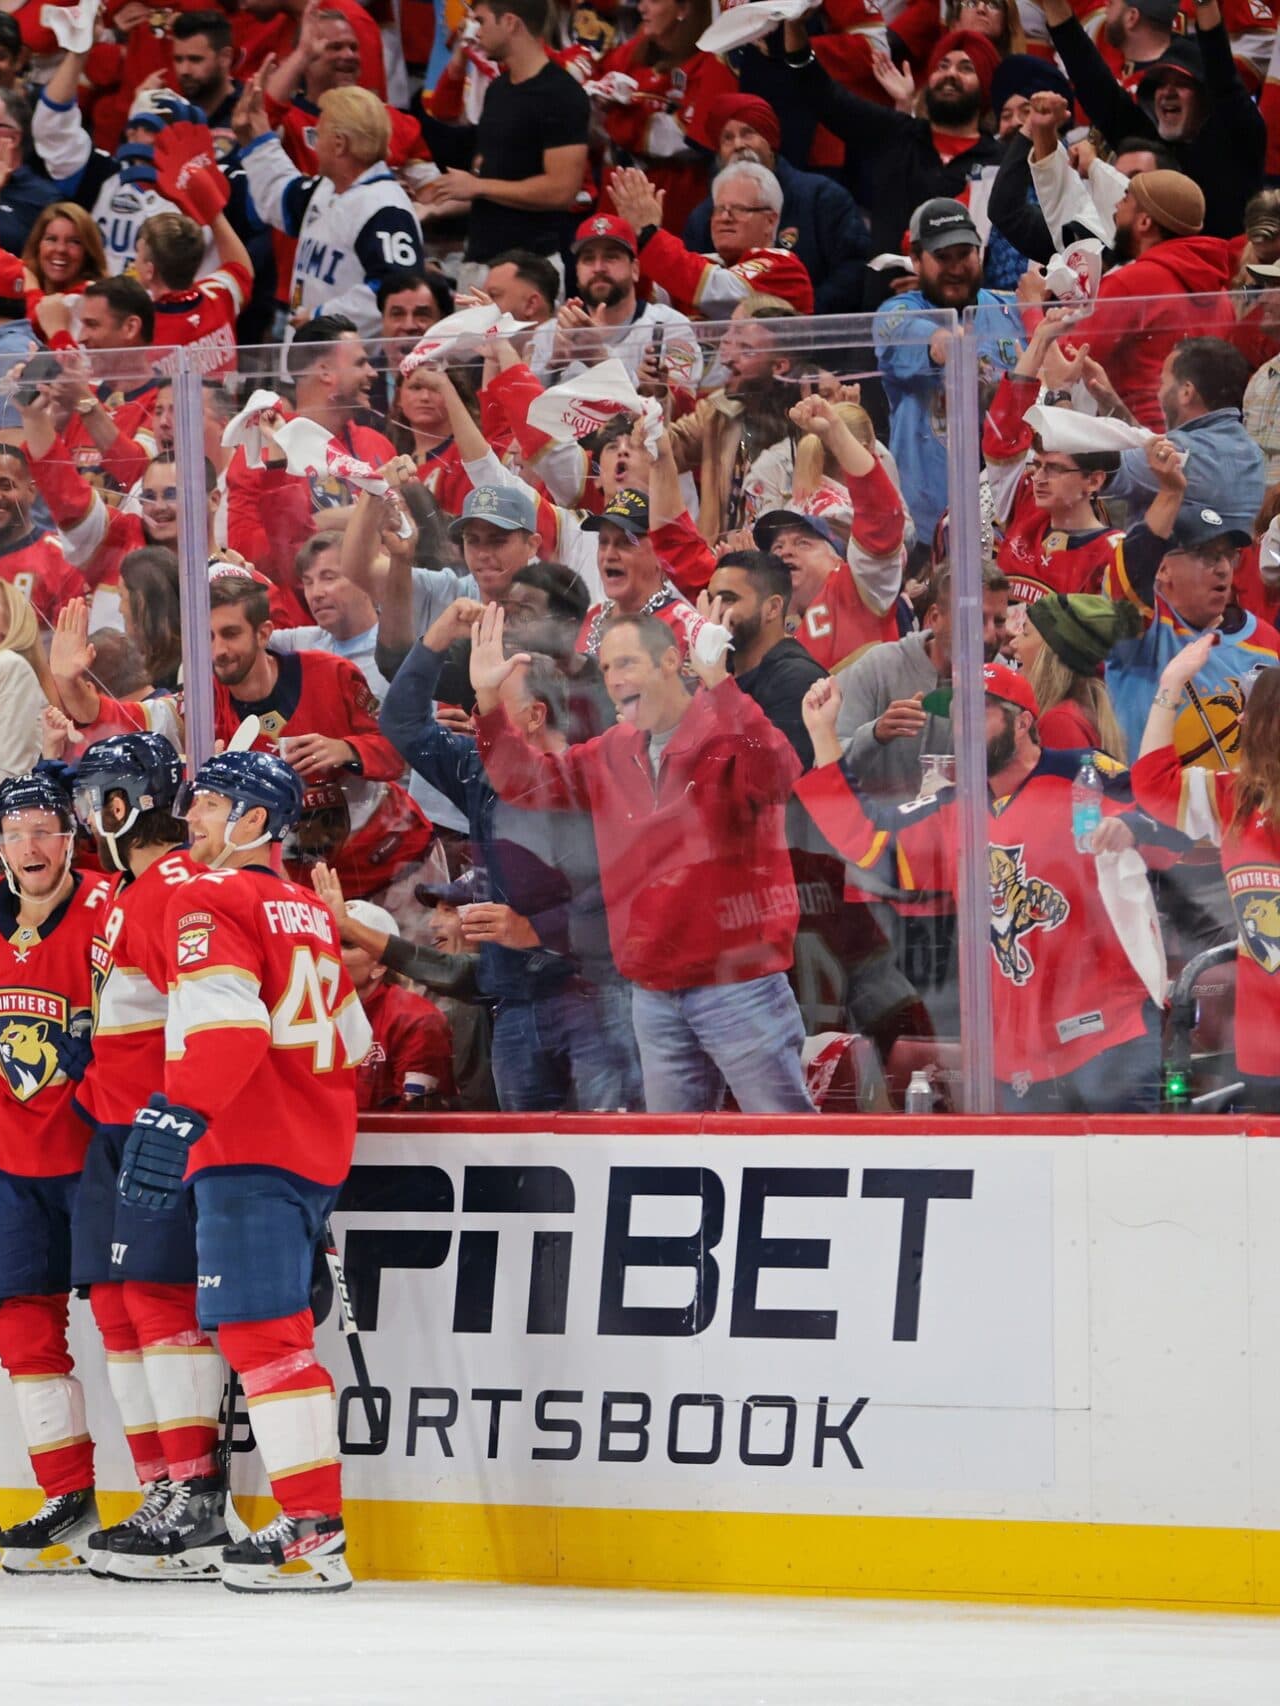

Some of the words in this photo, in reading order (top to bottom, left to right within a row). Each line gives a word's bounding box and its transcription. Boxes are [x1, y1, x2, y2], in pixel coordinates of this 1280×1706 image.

[376, 231, 417, 268] 16
[806, 606, 832, 639] C
[1230, 871, 1280, 892] PANTHER
[135, 1107, 194, 1138] CM
[313, 1164, 577, 1336] PN
[596, 1165, 975, 1342] BET
[219, 1384, 871, 1470] SORTSBOOK
